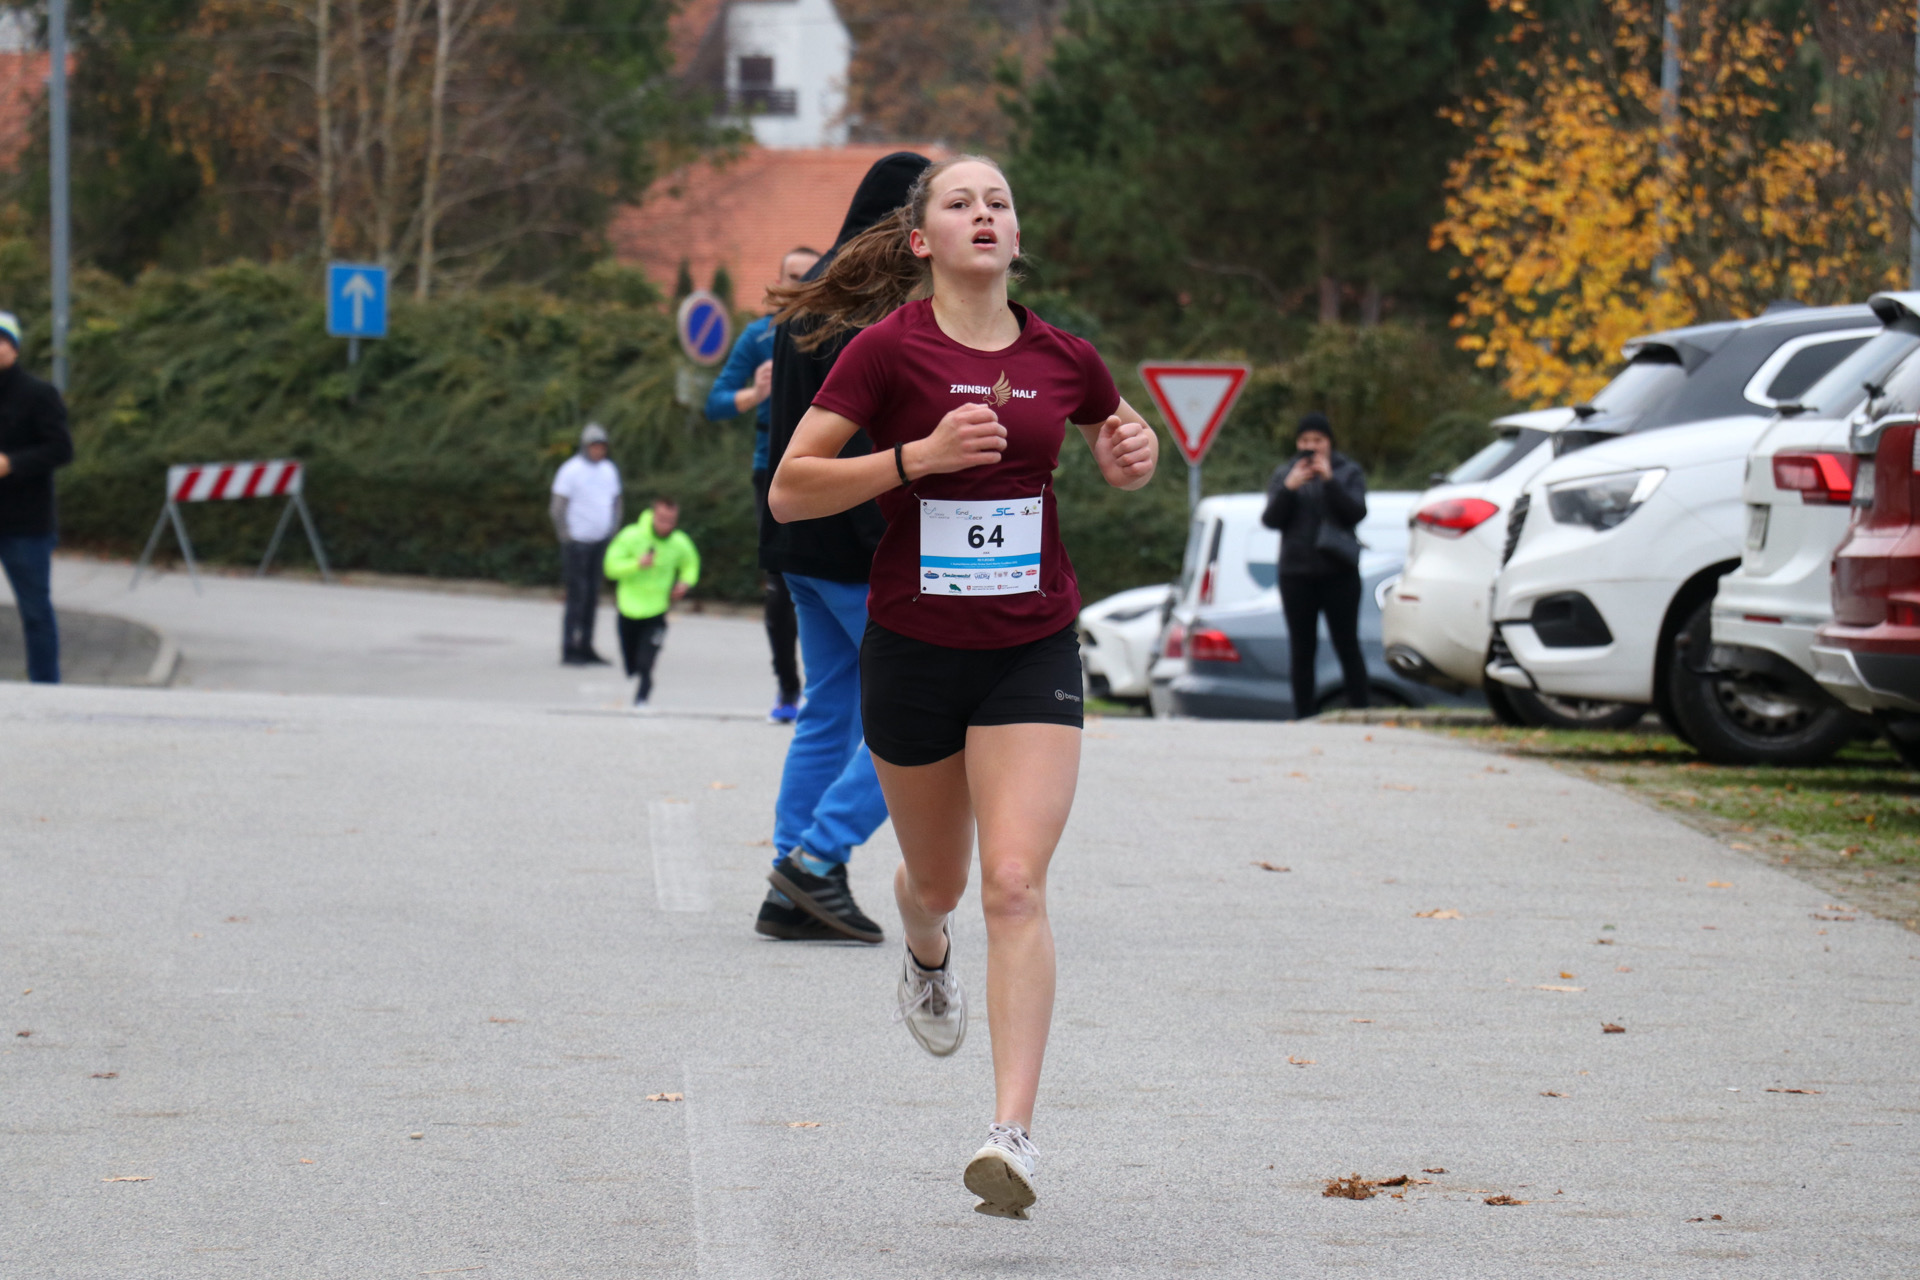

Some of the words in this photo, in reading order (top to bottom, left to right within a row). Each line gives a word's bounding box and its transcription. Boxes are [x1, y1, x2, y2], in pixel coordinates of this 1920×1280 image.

[949, 384, 991, 395] ZRINSKI
[1012, 389, 1037, 399] HALF
[968, 524, 1005, 549] 64
